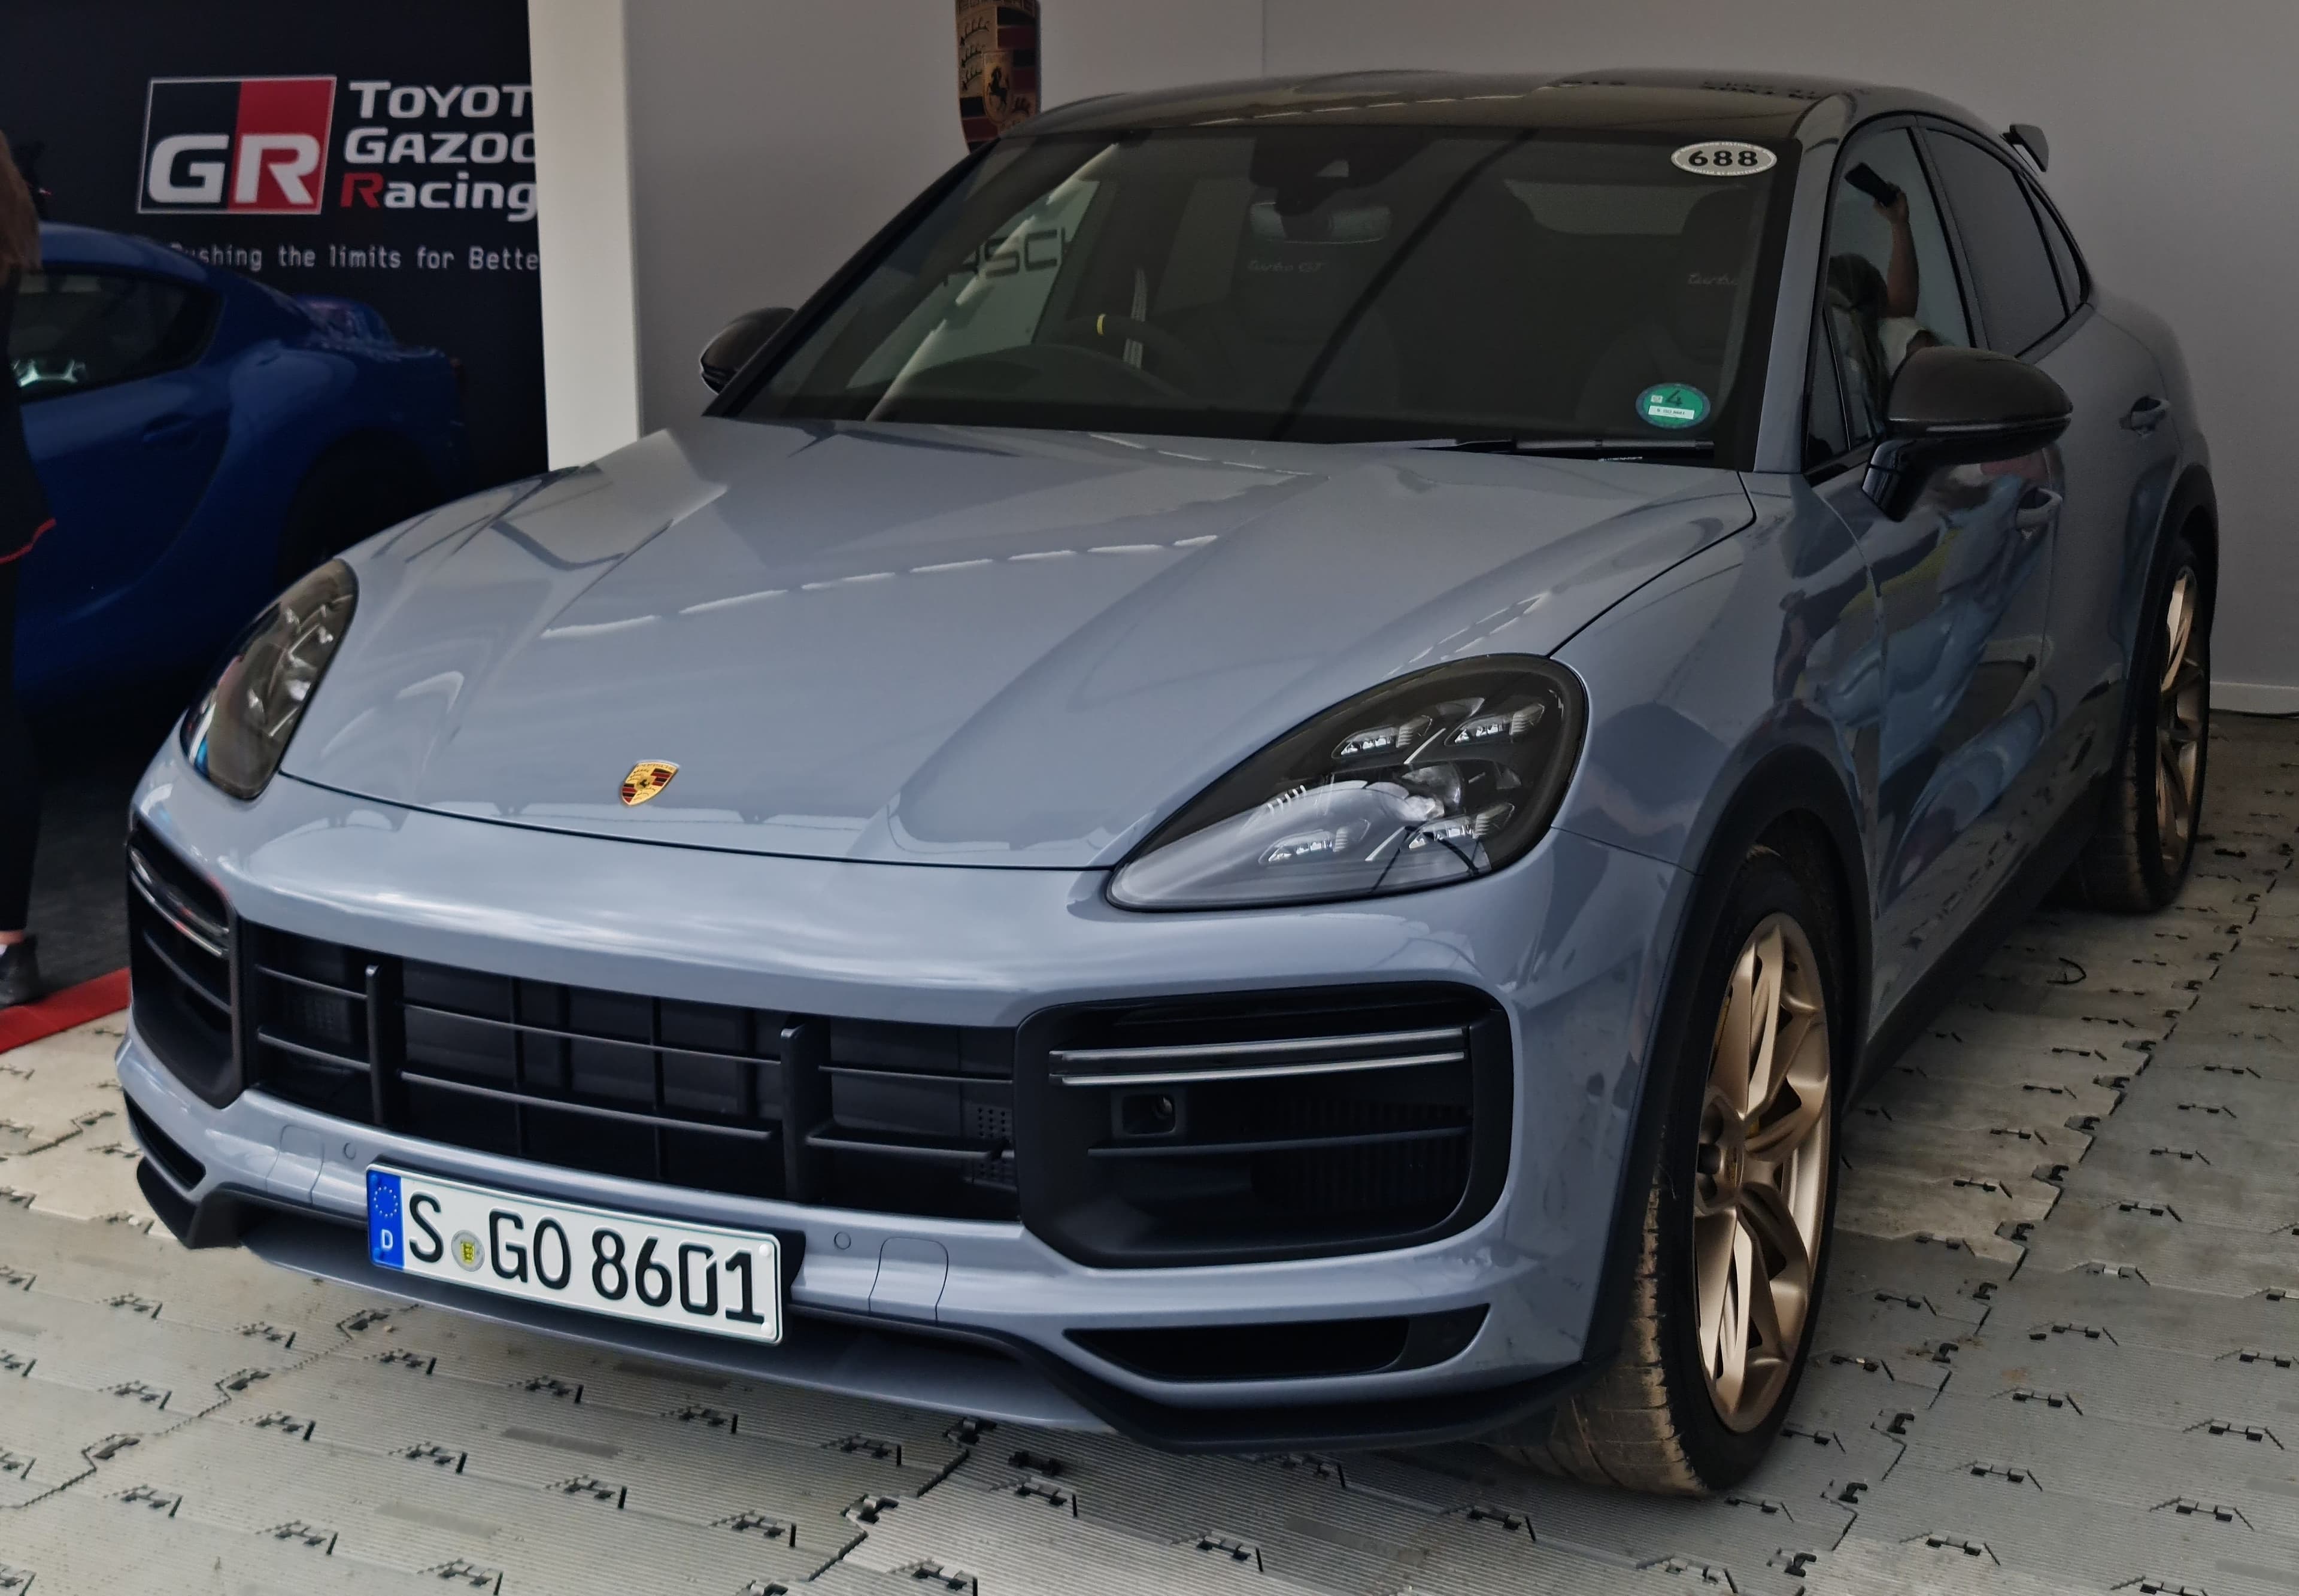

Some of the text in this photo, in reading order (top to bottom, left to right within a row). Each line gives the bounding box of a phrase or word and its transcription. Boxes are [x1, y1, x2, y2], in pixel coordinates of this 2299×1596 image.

[148, 133, 321, 205] GR
[1688, 150, 1758, 167] 688
[340, 172, 538, 222] Racing
[171, 242, 262, 272] shing
[278, 244, 316, 268] the
[329, 244, 401, 269] limits
[417, 245, 455, 269] for
[380, 1228, 394, 1251] D
[410, 1193, 765, 1325] S GO 8601
